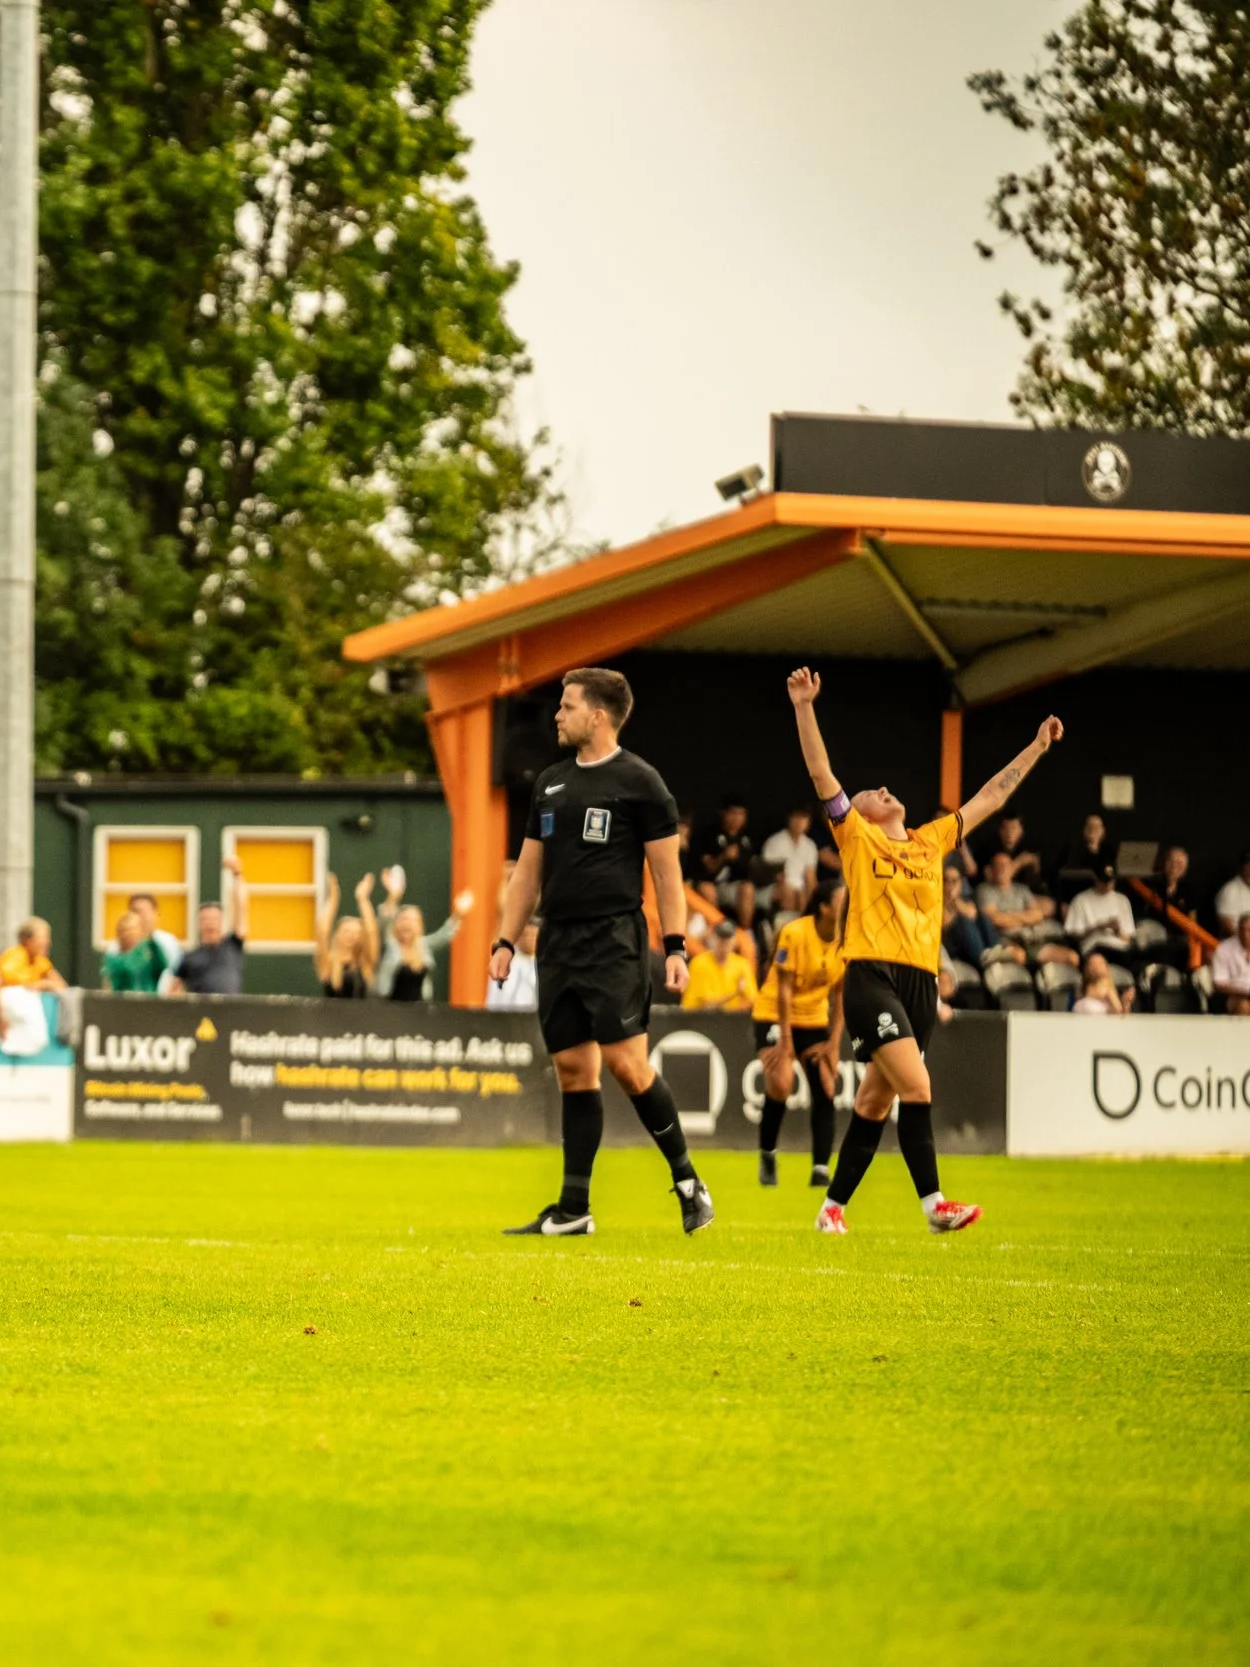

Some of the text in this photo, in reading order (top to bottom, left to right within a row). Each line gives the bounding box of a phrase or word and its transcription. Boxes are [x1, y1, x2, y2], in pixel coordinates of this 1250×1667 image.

[84, 1024, 197, 1073] Luxor
[230, 1031, 319, 1059] Hashrate
[320, 1033, 364, 1064] paid
[365, 1033, 394, 1062] for
[505, 1042, 533, 1066] us
[230, 1060, 274, 1088] how
[401, 1066, 448, 1093] work
[450, 1066, 477, 1093] for
